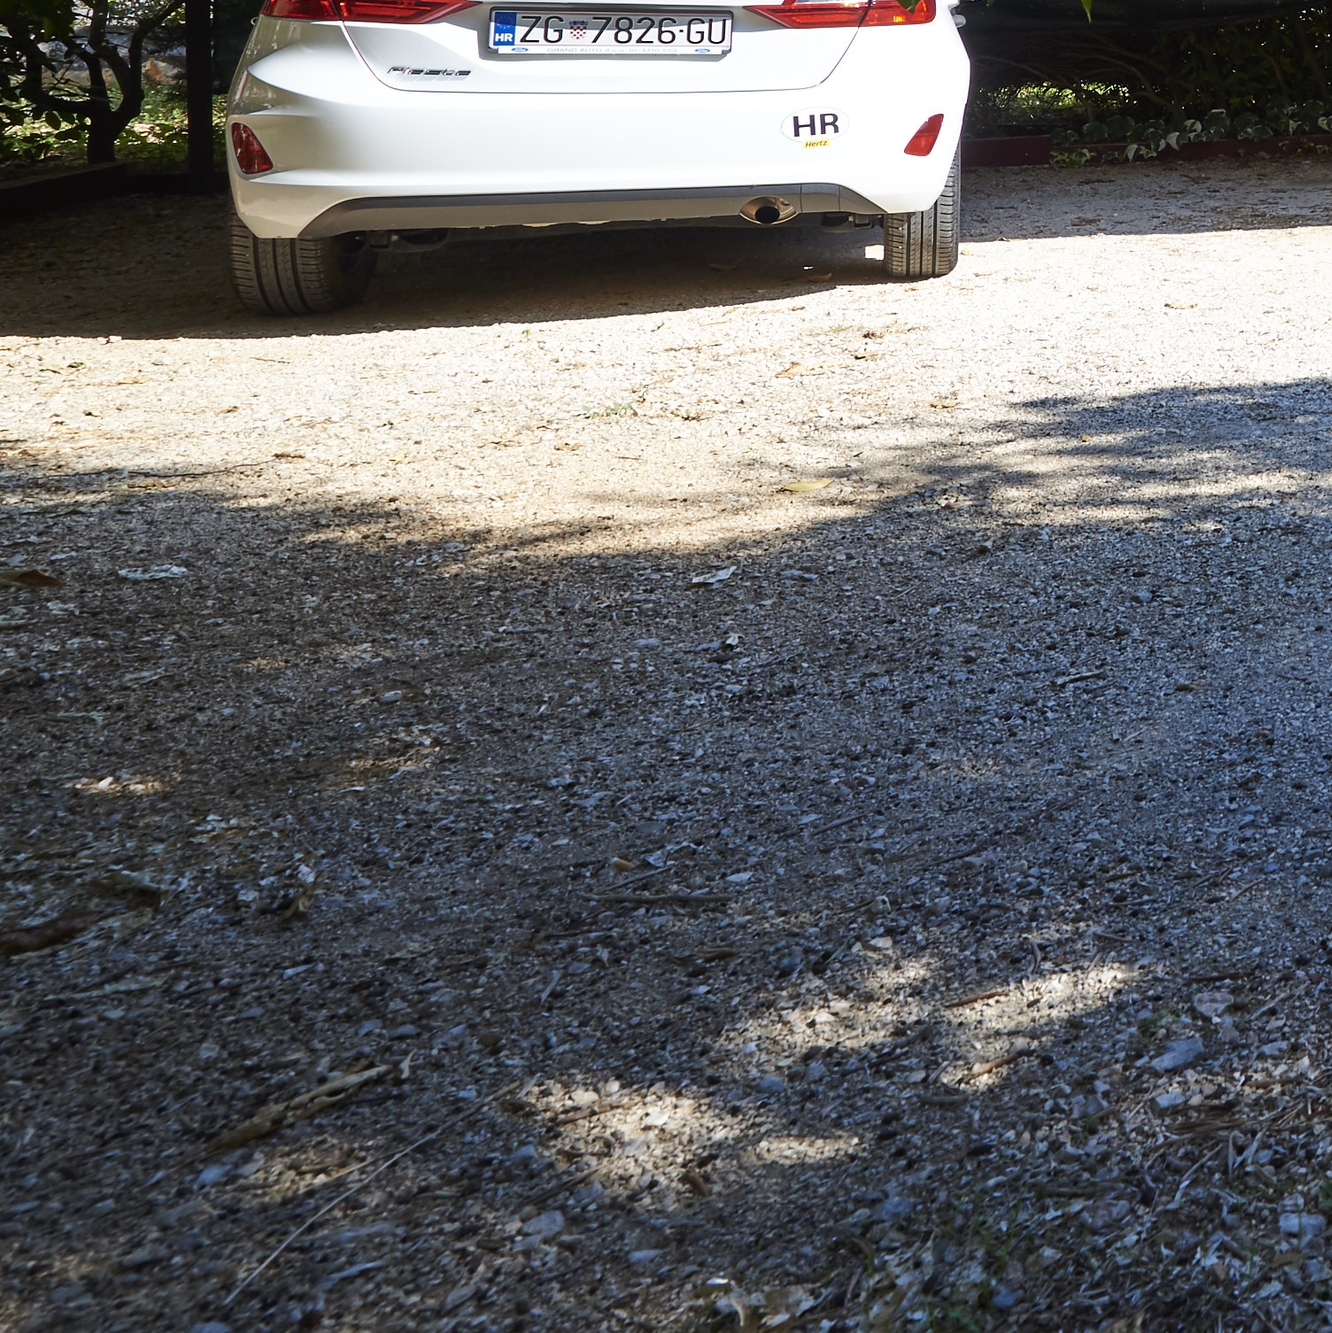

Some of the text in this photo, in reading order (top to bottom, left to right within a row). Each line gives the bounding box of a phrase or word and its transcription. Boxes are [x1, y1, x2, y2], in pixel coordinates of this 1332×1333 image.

[495, 33, 513, 42] HR
[520, 16, 727, 44] ZG 7826-GU
[793, 113, 839, 137] HR
